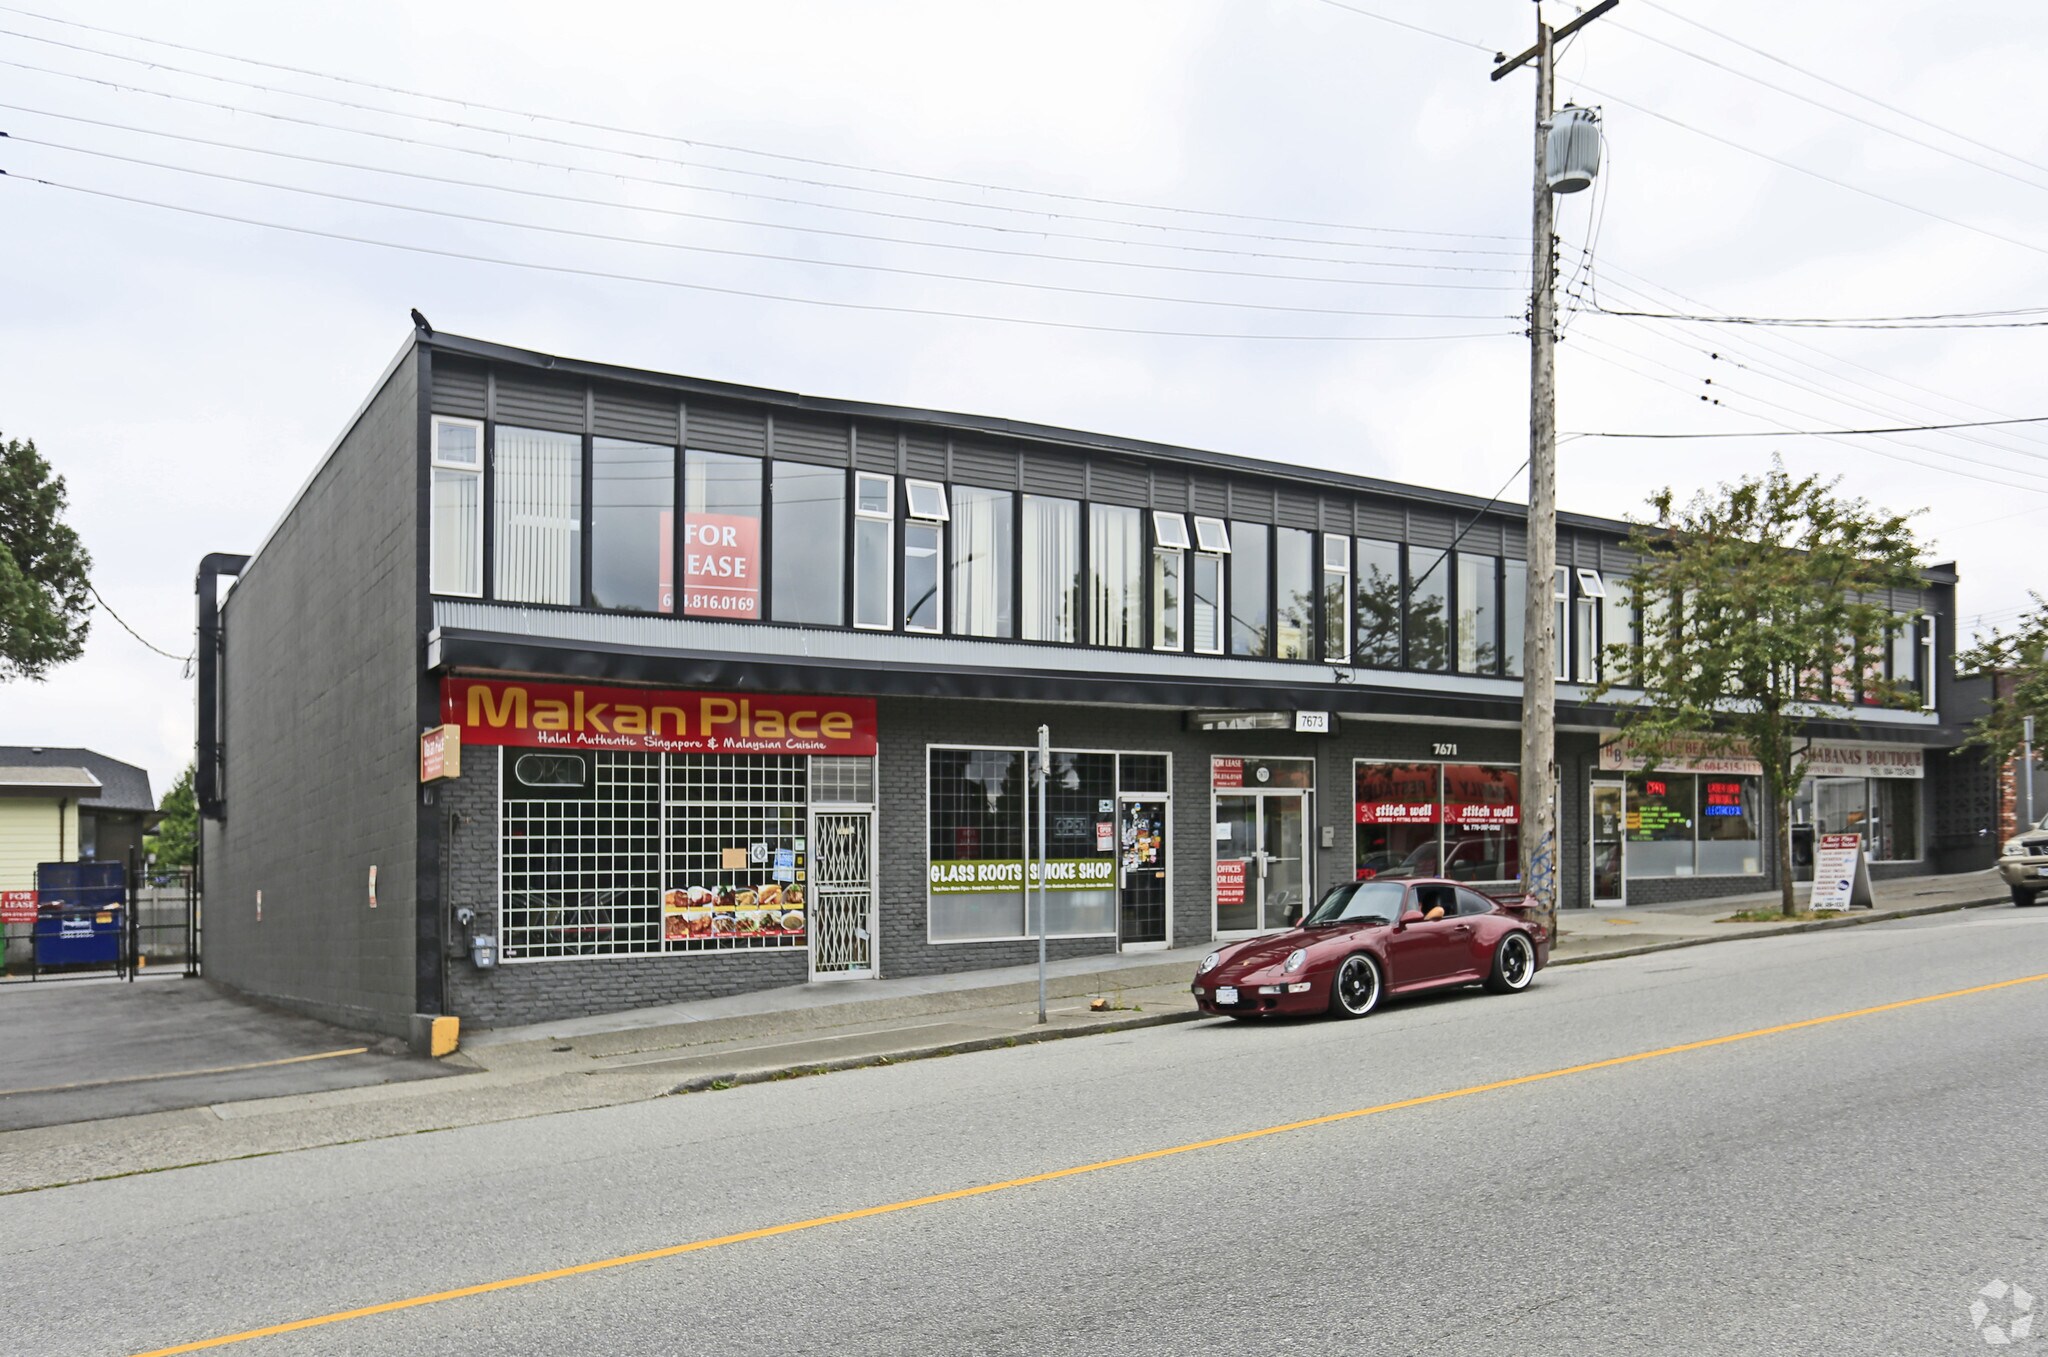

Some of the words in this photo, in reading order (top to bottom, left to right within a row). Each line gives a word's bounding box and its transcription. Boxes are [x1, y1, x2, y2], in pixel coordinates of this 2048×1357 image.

[685, 524, 737, 547] FOR
[685, 554, 746, 578] EASE
[467, 685, 687, 736] Makan
[700, 697, 854, 739] Place
[1301, 715, 1324, 728] 7673
[538, 731, 571, 744] Halal
[576, 732, 637, 746] Authentic
[643, 736, 703, 750] Singapore
[707, 737, 719, 750] &
[723, 738, 781, 750] Malaysian
[786, 738, 827, 750] Cuisine
[1432, 743, 1458, 756] 7671
[1866, 750, 1921, 767] BOUTIQUE
[1375, 804, 1406, 816] stitch
[1410, 804, 1432, 816] well
[1462, 805, 1490, 817] stitch
[1493, 805, 1514, 817] well
[931, 864, 975, 882] GLASS
[978, 863, 1022, 882] ROOTS
[1078, 862, 1112, 879] SHOP
[1217, 865, 1241, 873] OFFICES
[1228, 875, 1244, 883] LEASE
